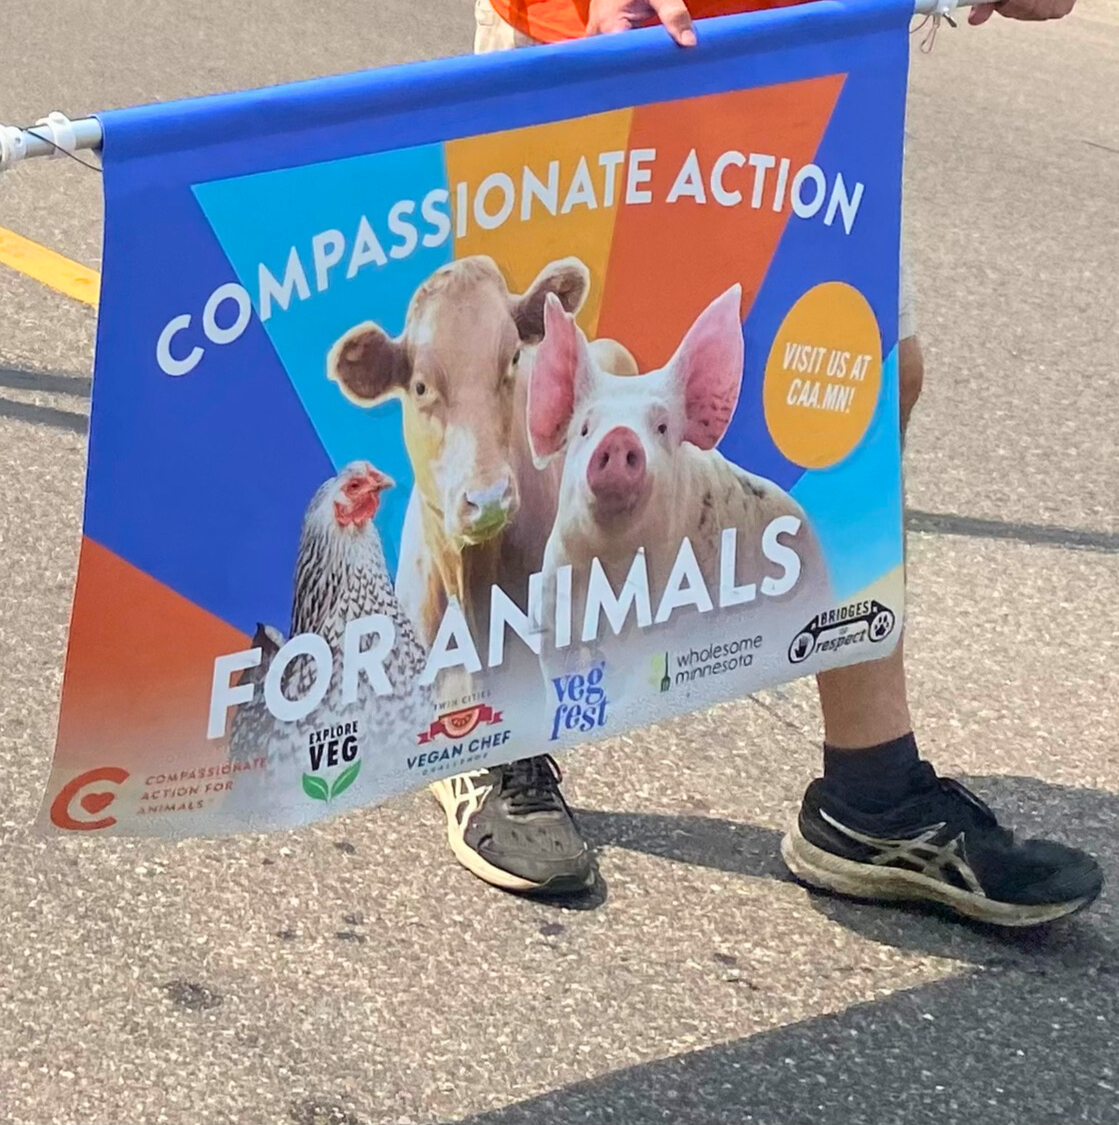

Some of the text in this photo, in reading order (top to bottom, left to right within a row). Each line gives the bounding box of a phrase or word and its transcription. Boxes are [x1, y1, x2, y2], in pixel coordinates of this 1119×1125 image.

[156, 148, 865, 377] COMPASSIONATE ACTION
[783, 341, 873, 382] VISIT US AT
[786, 377, 856, 414] CAA.MN!
[207, 514, 803, 740] FOR ANIMALS
[820, 600, 870, 626] BRIDGES
[676, 634, 764, 668] wholesome
[815, 627, 868, 654] respect
[551, 660, 606, 706] veg
[675, 652, 754, 686] minnesota
[309, 719, 359, 745] EXPLORE
[549, 694, 610, 741] fest
[309, 735, 358, 772] VEG
[406, 730, 512, 771] VEGAN CHEF
[145, 757, 268, 786] COMPASSIONATE
[137, 799, 204, 815] ANIMALS
[140, 780, 234, 801] ACTION FOR
